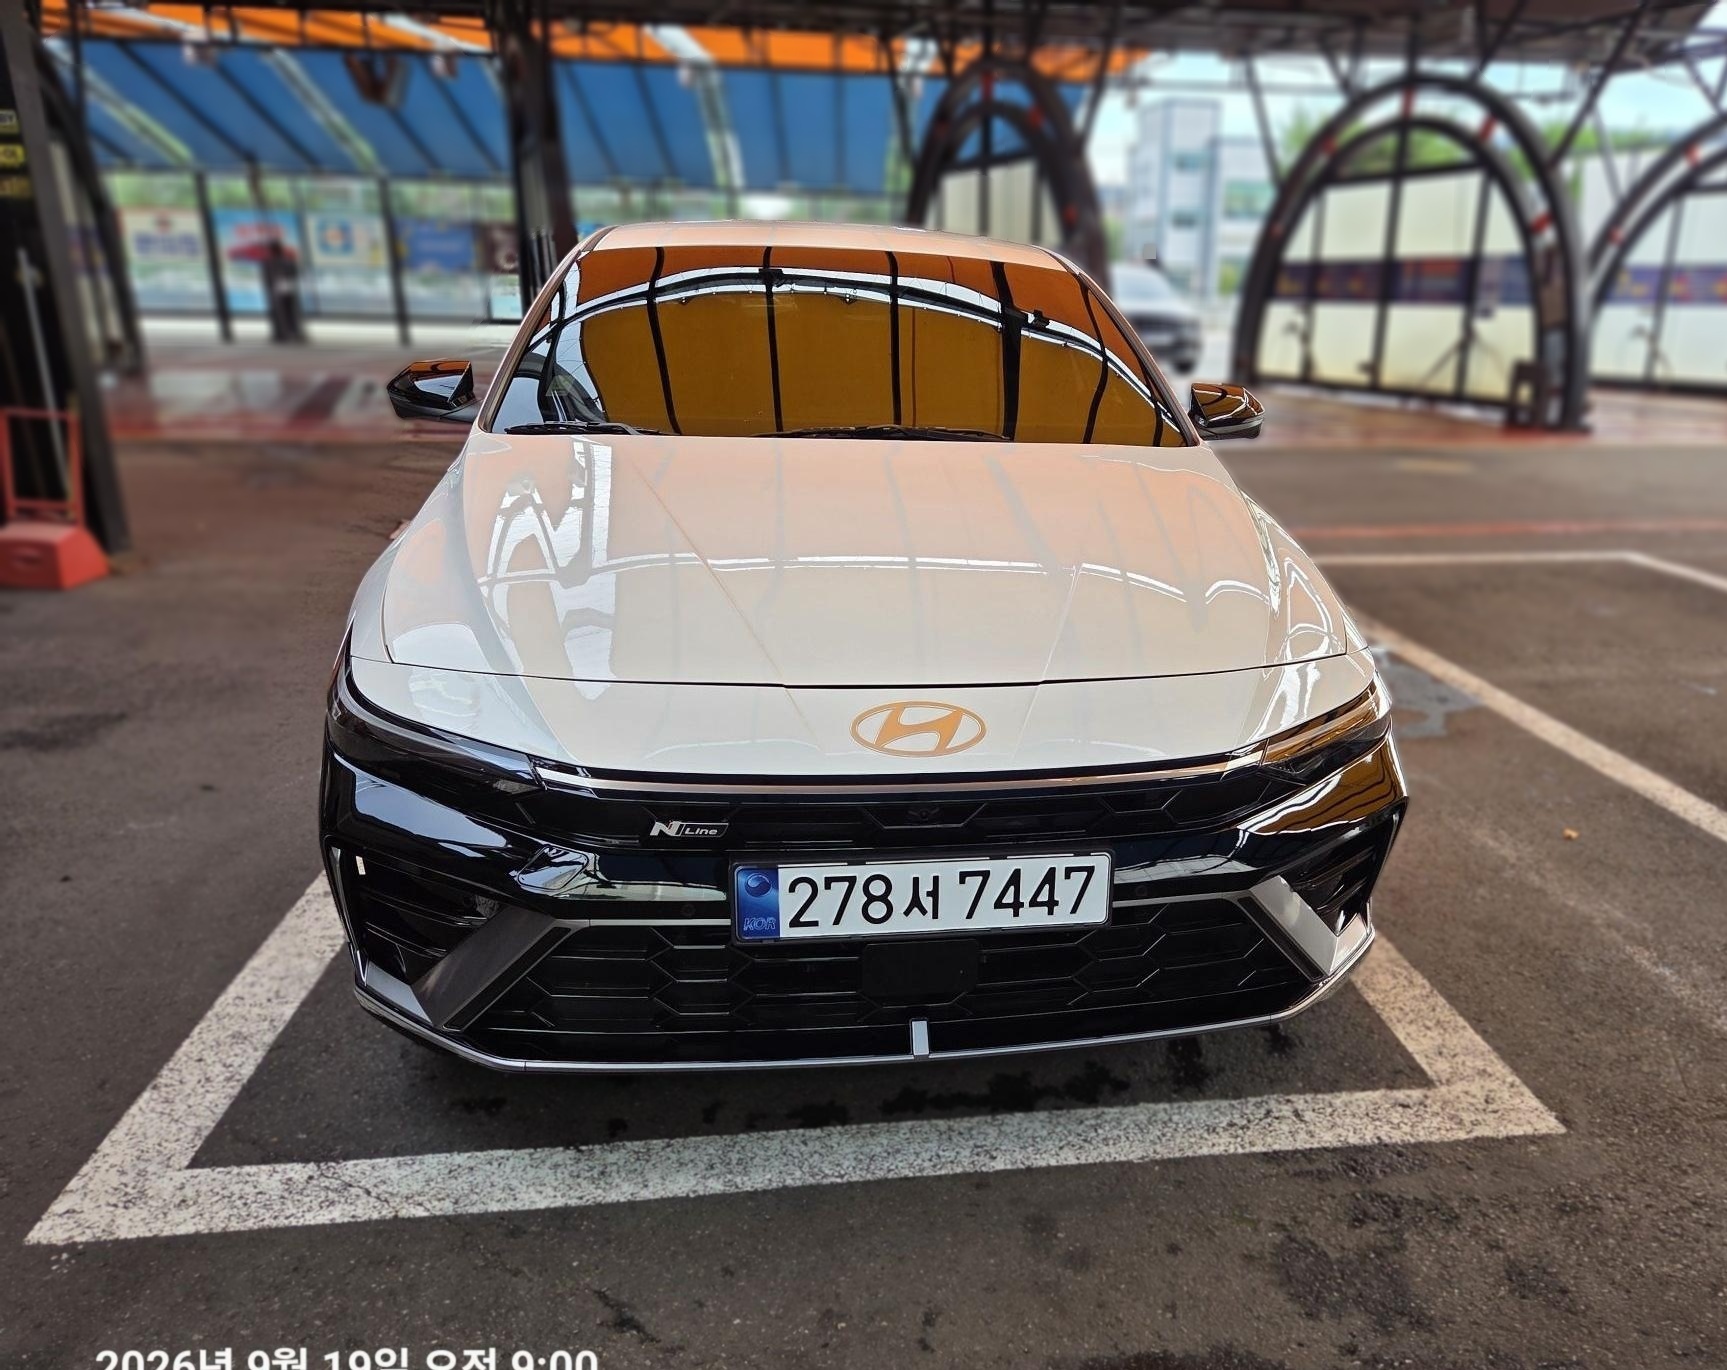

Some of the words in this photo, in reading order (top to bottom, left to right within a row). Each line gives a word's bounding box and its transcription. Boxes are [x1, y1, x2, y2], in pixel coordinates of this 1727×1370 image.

[650, 821, 680, 836] N
[788, 874, 940, 928] 278서
[957, 865, 1096, 919] 7447
[743, 917, 776, 931] KOR
